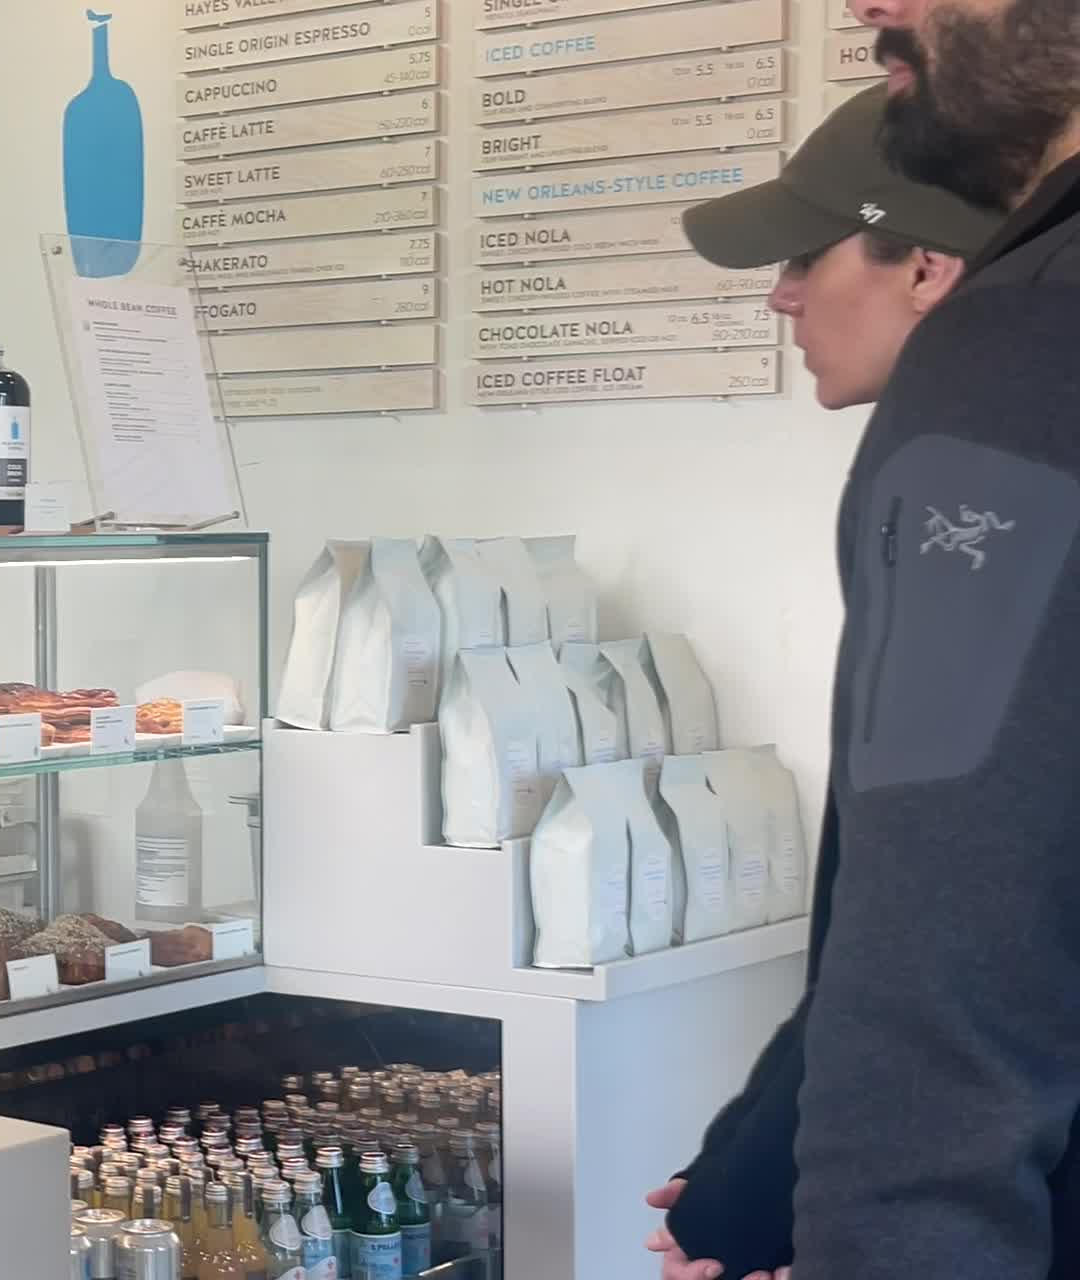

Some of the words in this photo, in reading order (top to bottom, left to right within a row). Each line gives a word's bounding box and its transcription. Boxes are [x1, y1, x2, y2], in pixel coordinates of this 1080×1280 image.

[424, 6, 431, 18] 5
[184, 40, 234, 61] SINGLE
[238, 32, 289, 54] ORIGIN
[294, 22, 370, 46] ESPRESSO
[485, 44, 524, 64] ICED
[529, 35, 597, 58] COFFEE
[408, 51, 431, 65] 5.75
[839, 44, 873, 65] HO
[695, 63, 713, 76] 5.5
[755, 56, 775, 70] 6.5
[184, 79, 278, 104] CAPPUCCINO
[481, 89, 526, 108] BOLD
[421, 98, 429, 110] 6
[695, 113, 713, 127] 5.5
[755, 107, 774, 121] 6.5
[182, 122, 227, 145] CAFFÈ
[231, 120, 275, 139] LATTE
[481, 134, 542, 156] BRIGHT
[183, 170, 233, 189] SWEET
[237, 166, 281, 183] LATTE
[481, 187, 521, 205] NEW
[671, 167, 744, 188] COFFEE
[182, 209, 226, 231] CAFFÈ
[231, 209, 287, 226] MOCHA
[480, 232, 519, 249] ICED
[524, 229, 571, 246] NOLA
[185, 254, 269, 273] SHAKERATO
[480, 279, 516, 296] HOT
[520, 276, 567, 293] NOLA
[193, 302, 257, 320] FFOGATO
[690, 312, 710, 325] 6.5
[753, 309, 770, 321] 7.5
[478, 322, 580, 342] CHOCOLATE
[584, 320, 633, 337] NOLA
[761, 357, 769, 369] 9
[476, 373, 516, 389] ICED
[521, 368, 587, 387] COFFEE
[592, 366, 647, 384] FLOAT
